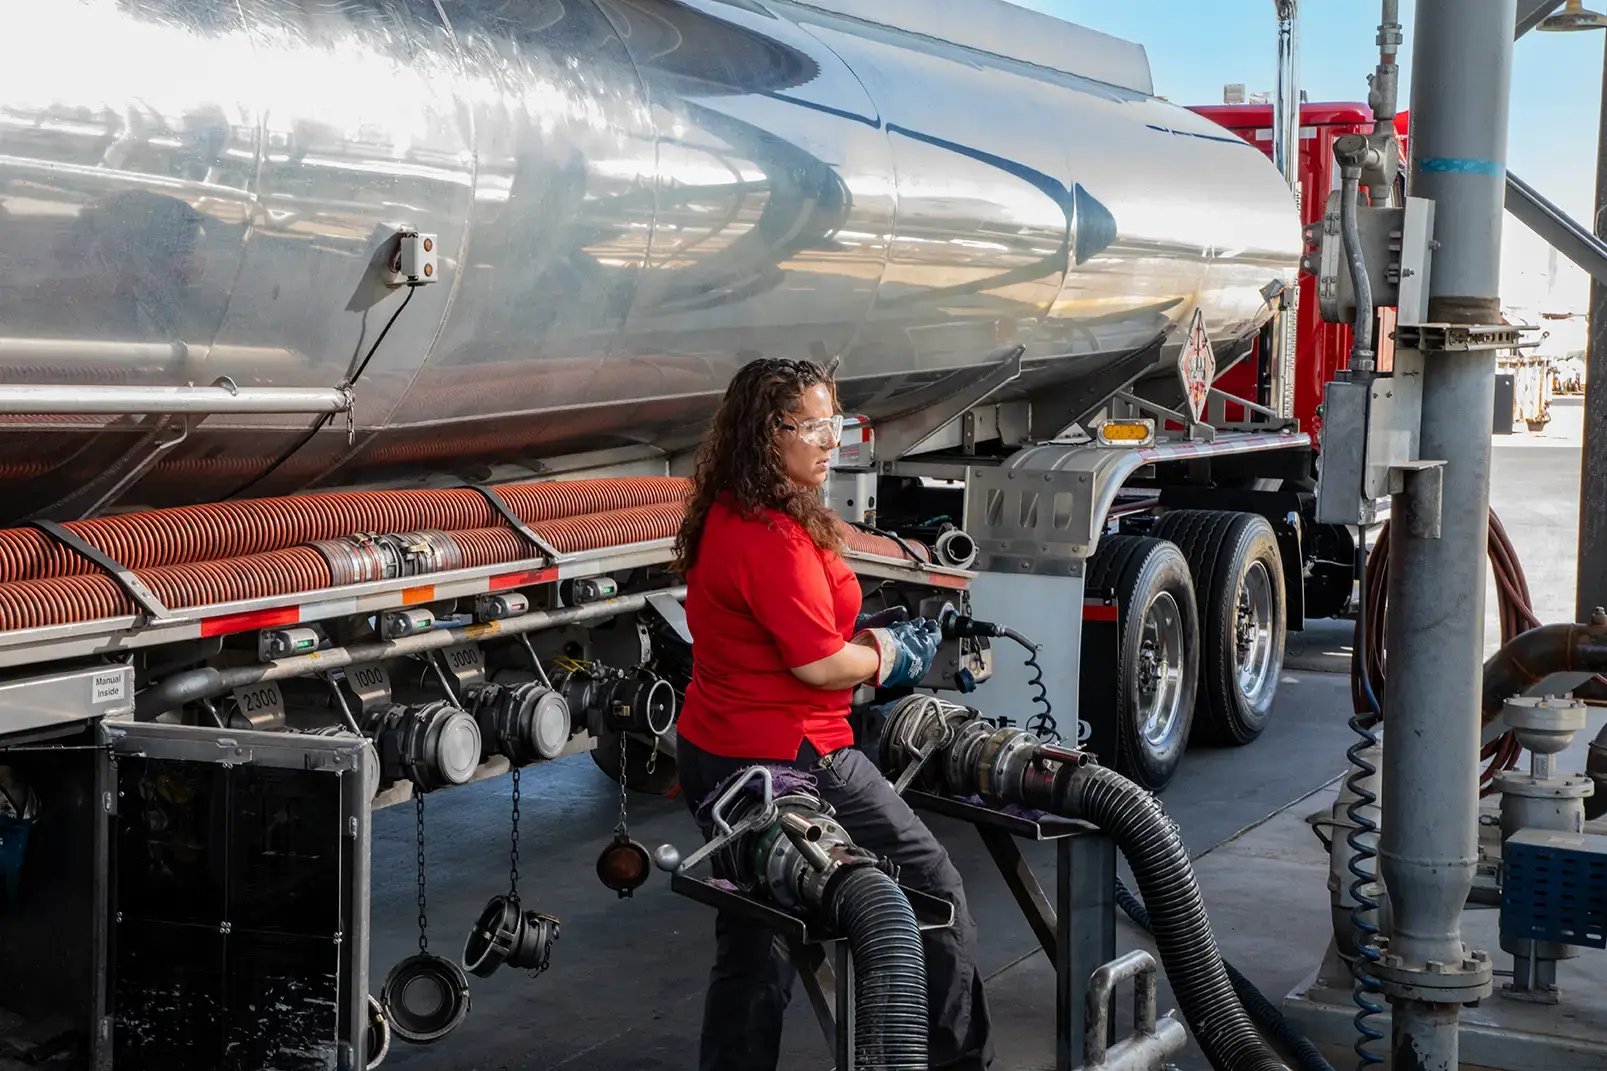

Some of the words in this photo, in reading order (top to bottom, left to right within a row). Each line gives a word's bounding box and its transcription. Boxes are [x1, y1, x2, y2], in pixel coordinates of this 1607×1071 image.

[450, 648, 478, 668] 3000
[96, 675, 121, 686] Manual
[354, 667, 384, 689] 1000
[97, 688, 119, 697] Inside
[243, 688, 278, 712] 2300
